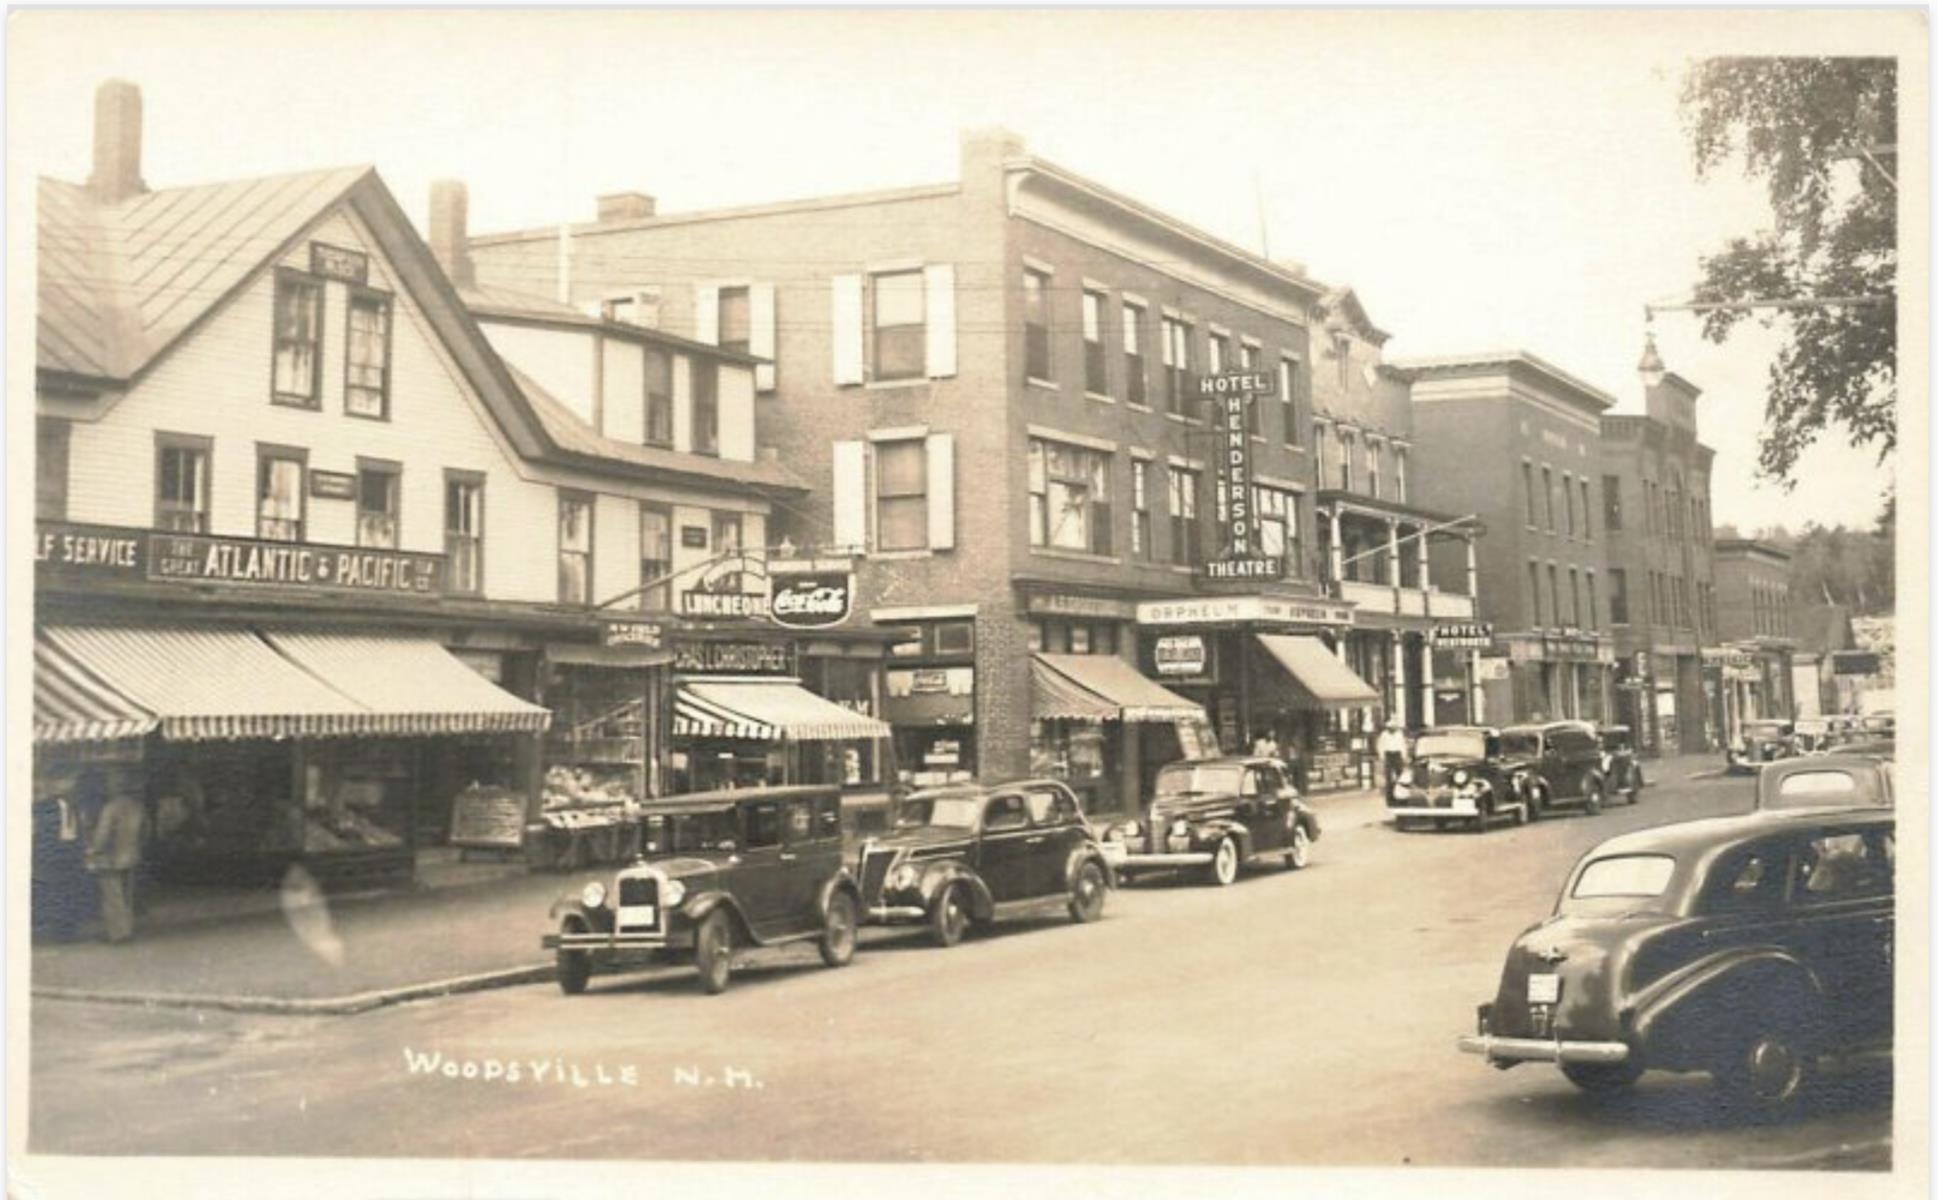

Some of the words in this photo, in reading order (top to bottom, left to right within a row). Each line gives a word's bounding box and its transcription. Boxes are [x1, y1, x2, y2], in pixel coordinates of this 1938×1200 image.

[1201, 376, 1266, 393] HOTEL
[1228, 398, 1247, 553] HENDERSON
[63, 536, 137, 568] SERVICE
[204, 544, 311, 582] ATLANTIC
[336, 554, 412, 590] PACIFIC
[1208, 559, 1276, 577] THEATRE
[1441, 625, 1485, 637] HOTEL
